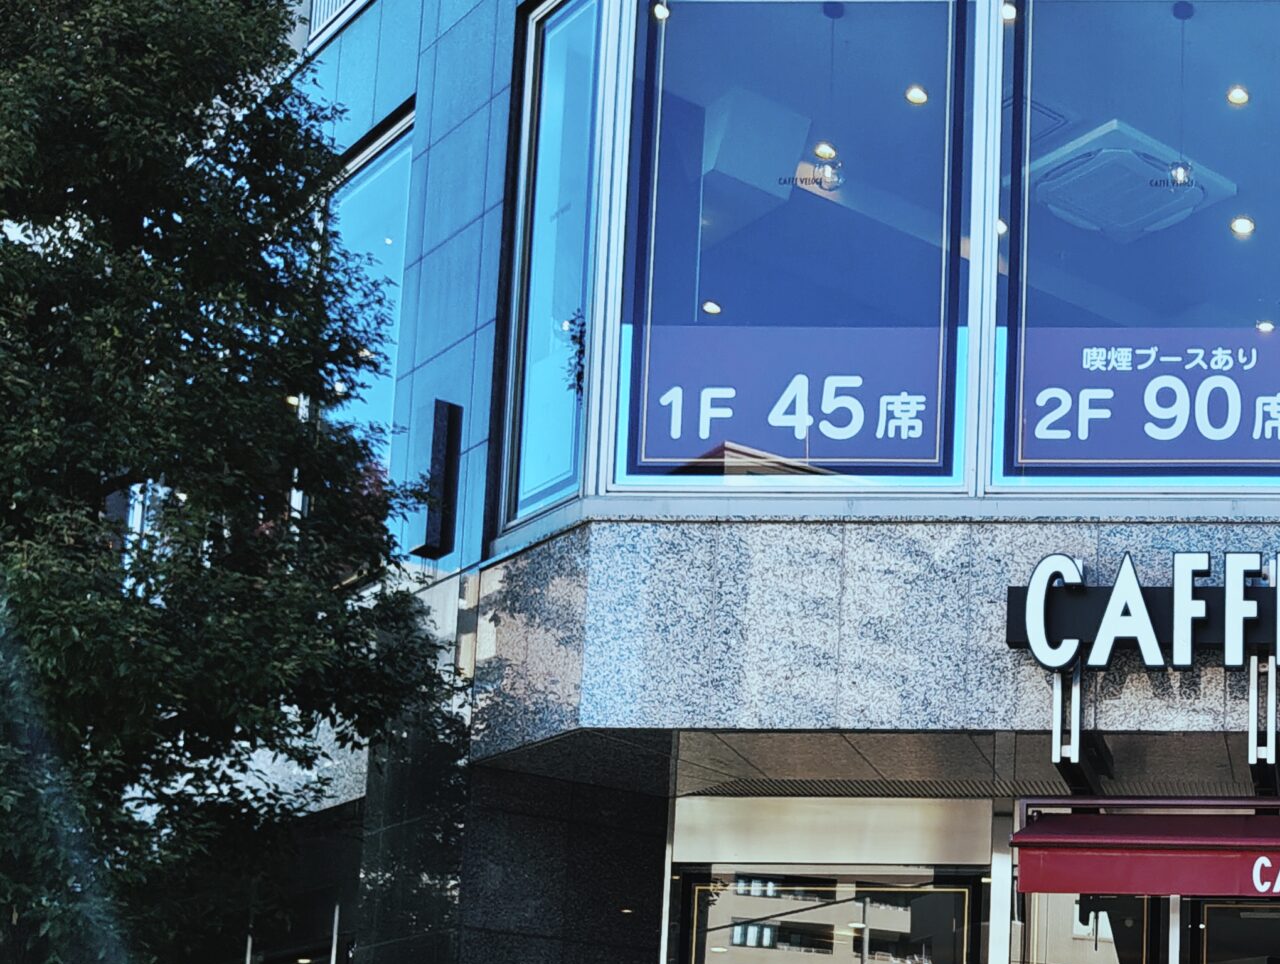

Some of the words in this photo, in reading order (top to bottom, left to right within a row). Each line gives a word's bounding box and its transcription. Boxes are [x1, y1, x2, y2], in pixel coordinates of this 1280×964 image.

[1082, 347, 1258, 371] 喫煙ブースあり
[659, 386, 737, 440] 1F
[1034, 387, 1115, 441] 2F
